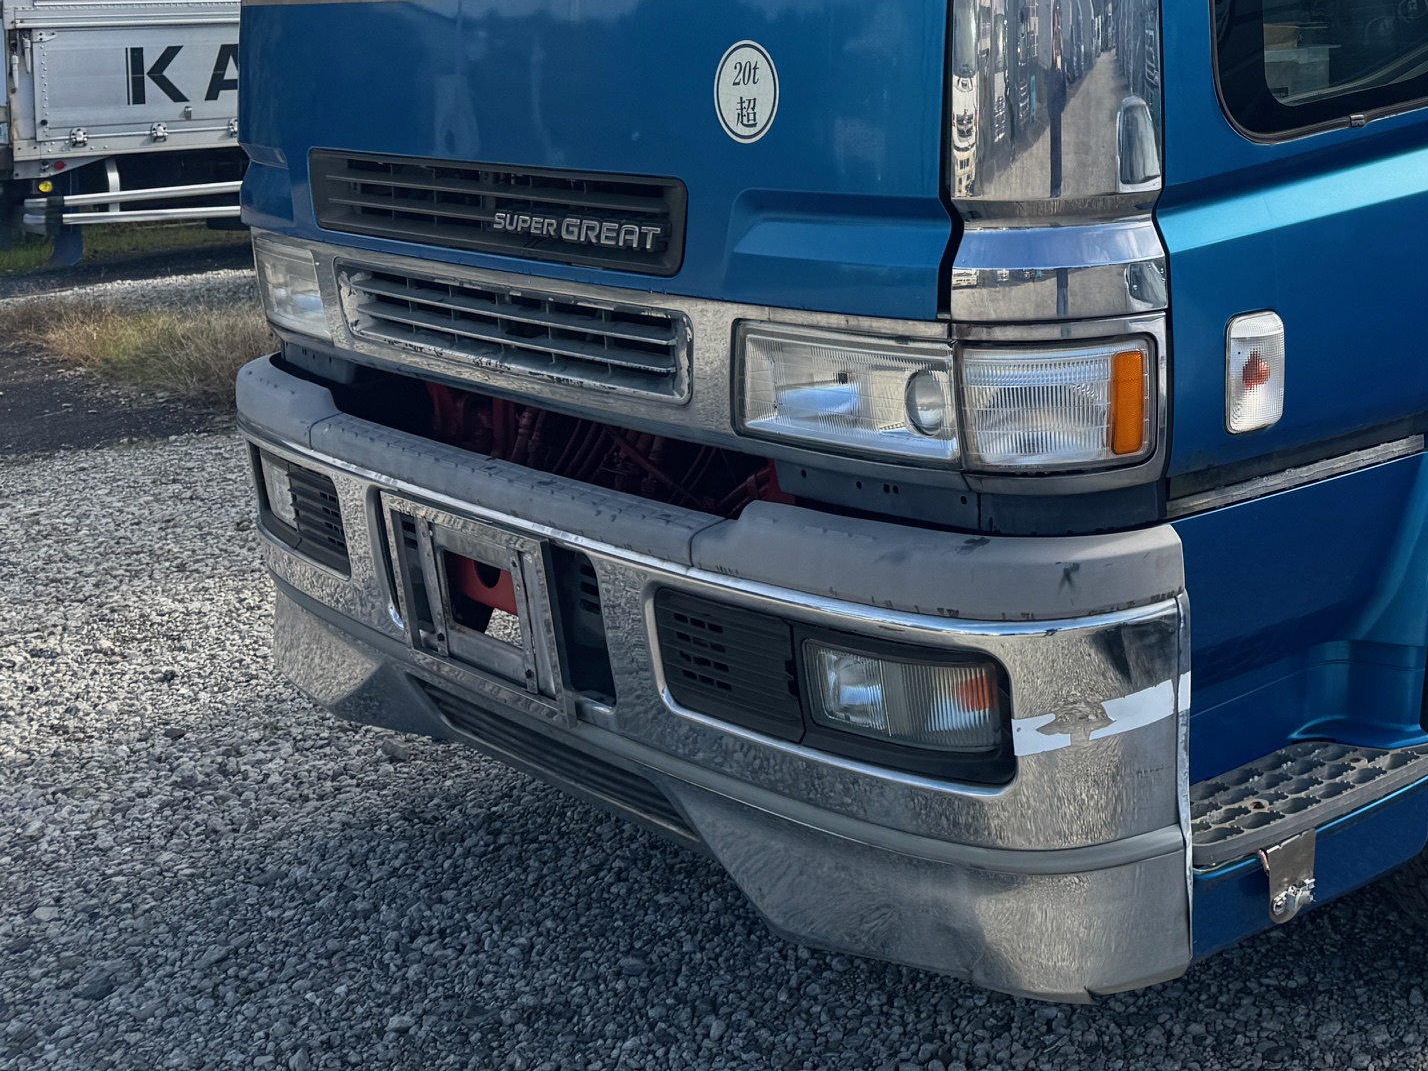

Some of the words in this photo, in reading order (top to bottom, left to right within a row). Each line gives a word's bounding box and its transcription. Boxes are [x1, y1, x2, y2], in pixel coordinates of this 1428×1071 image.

[732, 60, 760, 86] 20t
[736, 96, 758, 128] 超
[493, 212, 557, 236] SUPER
[561, 217, 661, 249] GREAT
